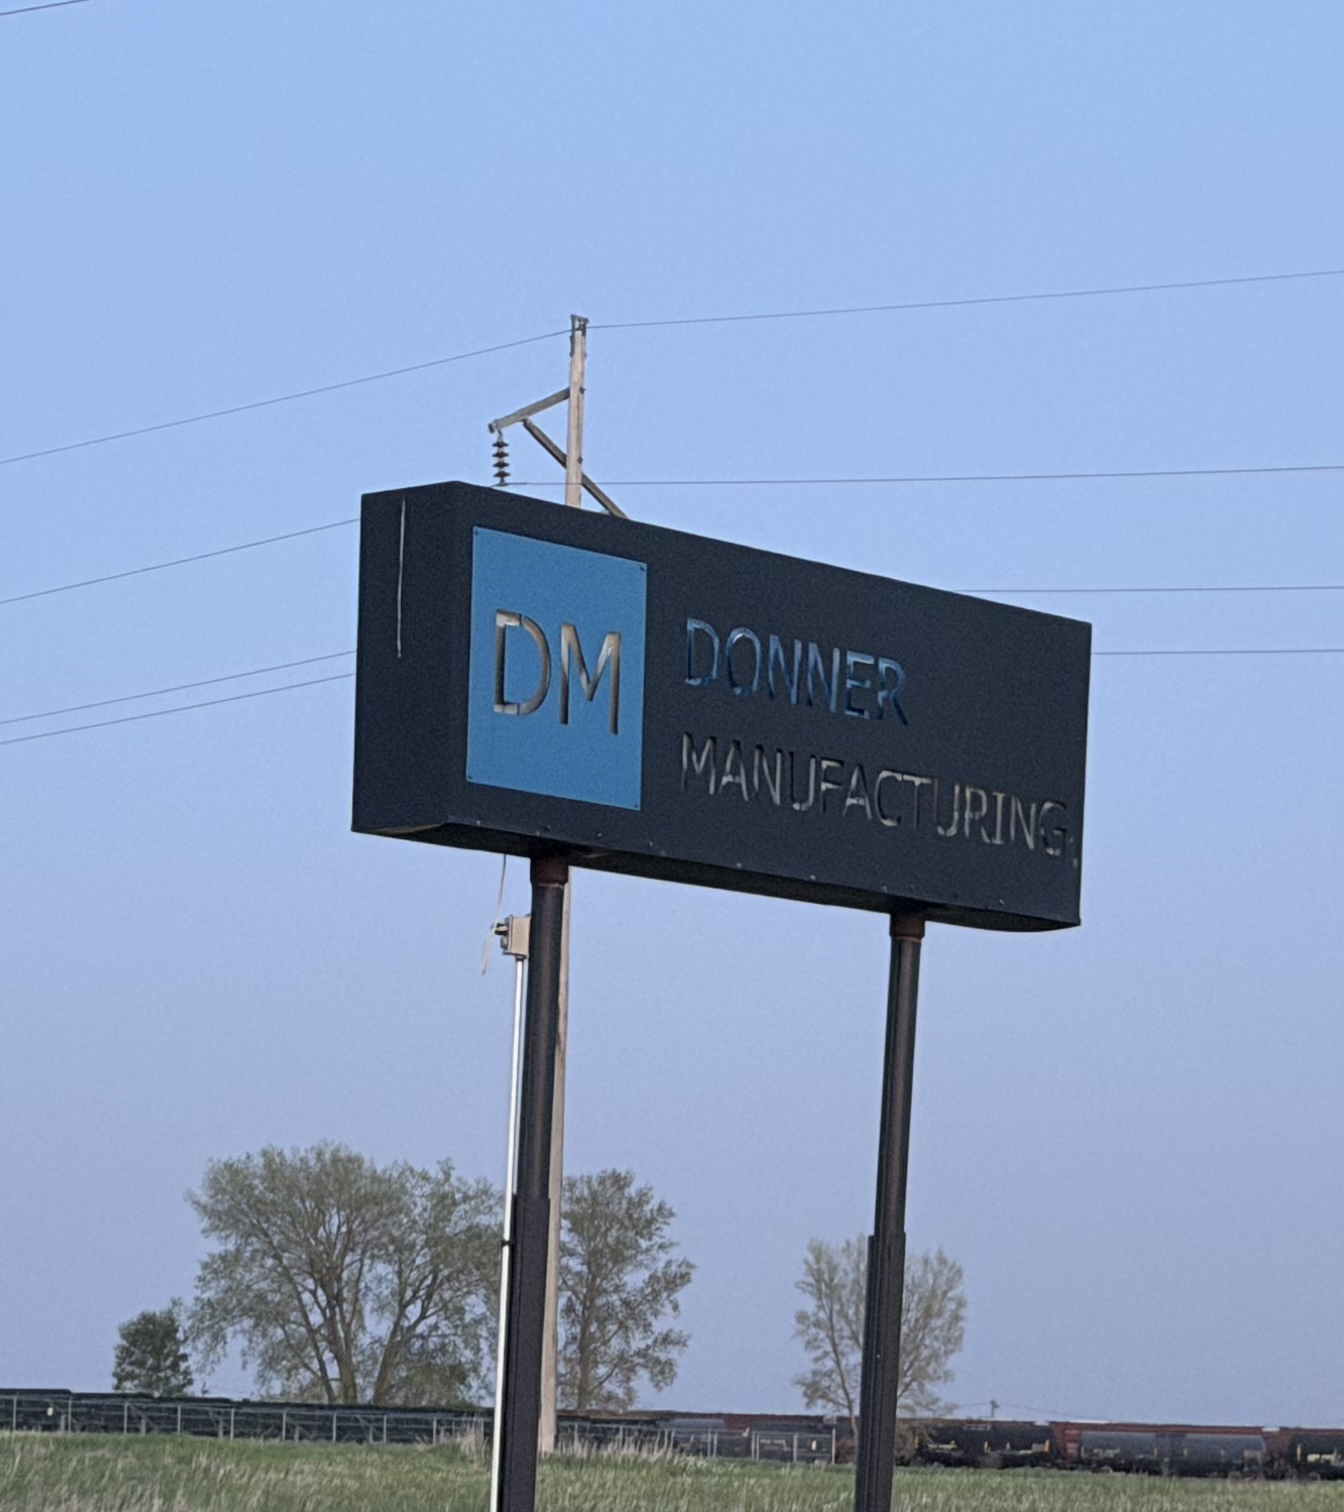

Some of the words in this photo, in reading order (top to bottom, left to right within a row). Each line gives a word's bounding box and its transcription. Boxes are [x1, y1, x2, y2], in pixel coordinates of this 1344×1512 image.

[494, 609, 621, 735] DM
[685, 617, 908, 726] DONNER
[681, 732, 1068, 856] MANUFACTURING
